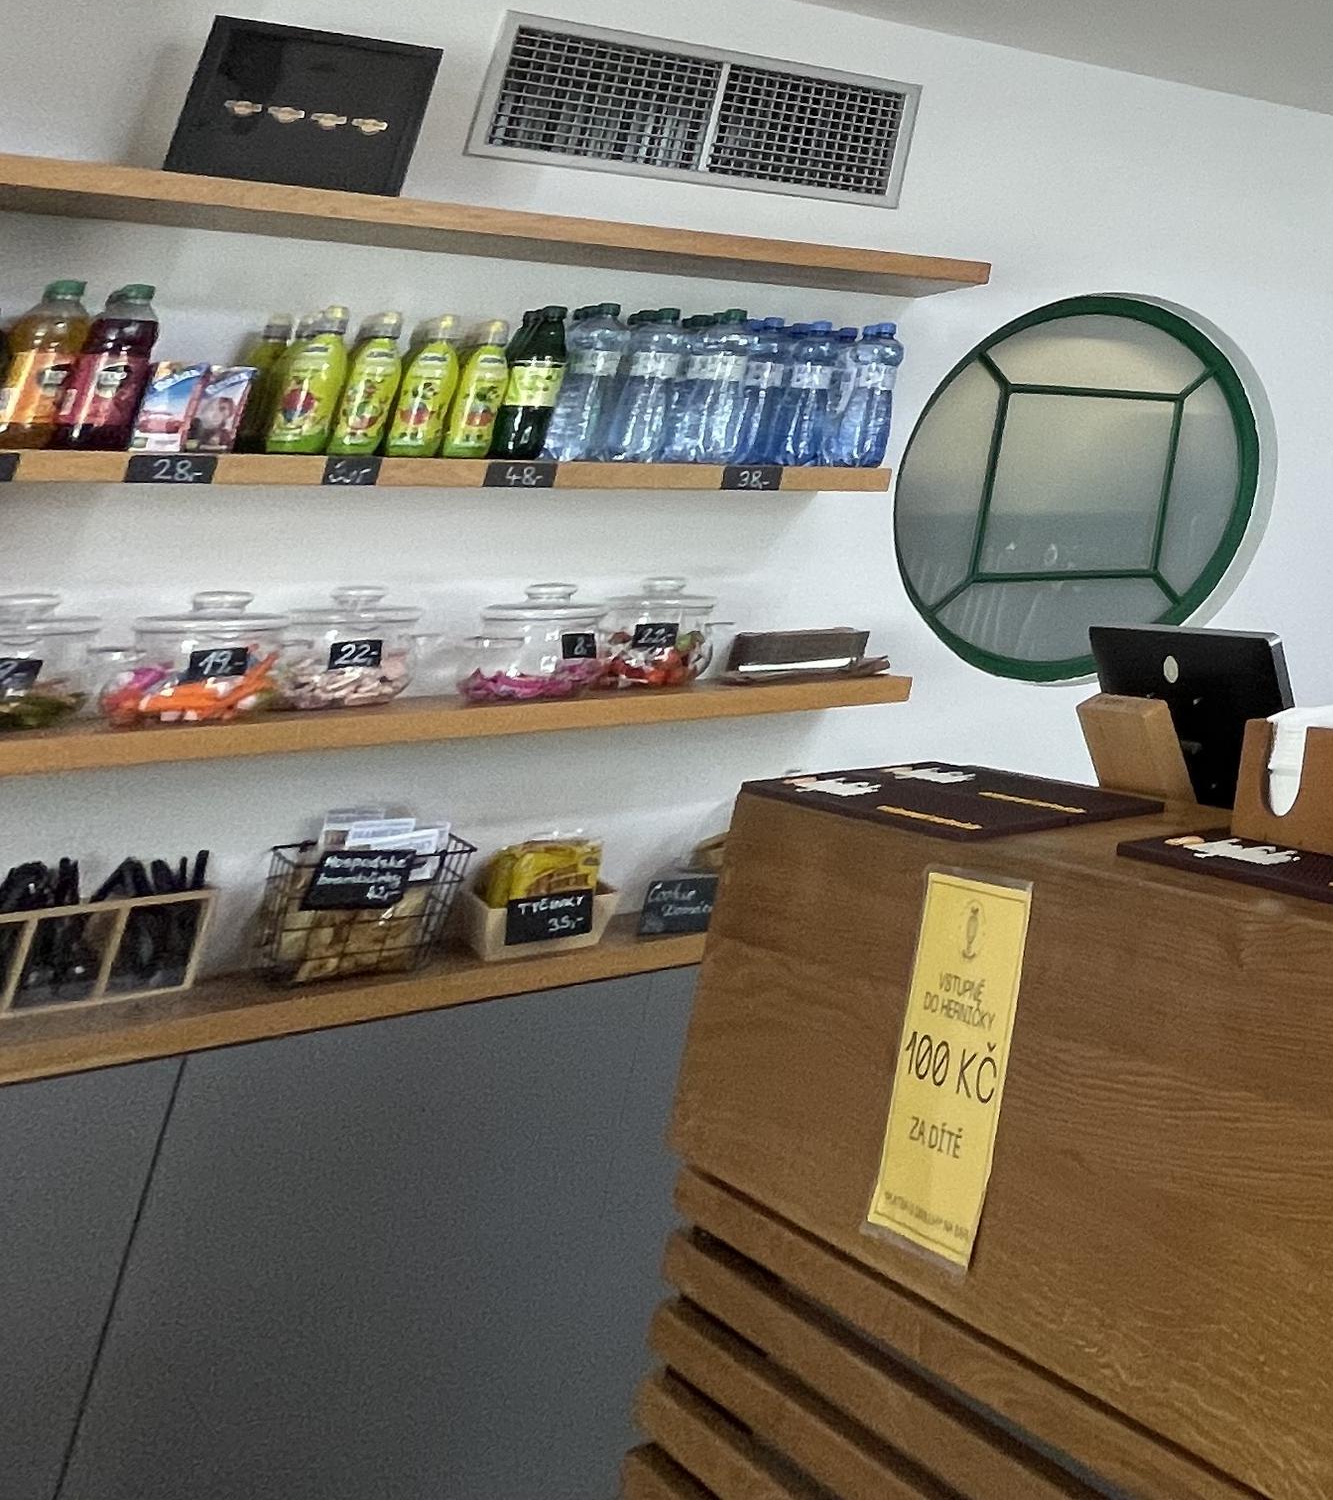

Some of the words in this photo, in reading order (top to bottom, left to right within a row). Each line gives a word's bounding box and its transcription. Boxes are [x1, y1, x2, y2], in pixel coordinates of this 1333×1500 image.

[923, 991, 939, 1013] DO
[905, 1031, 950, 1087] 100
[955, 1041, 998, 1104] KČ
[909, 1116, 926, 1145] ZA
[927, 1121, 964, 1159] DÍTĚ
